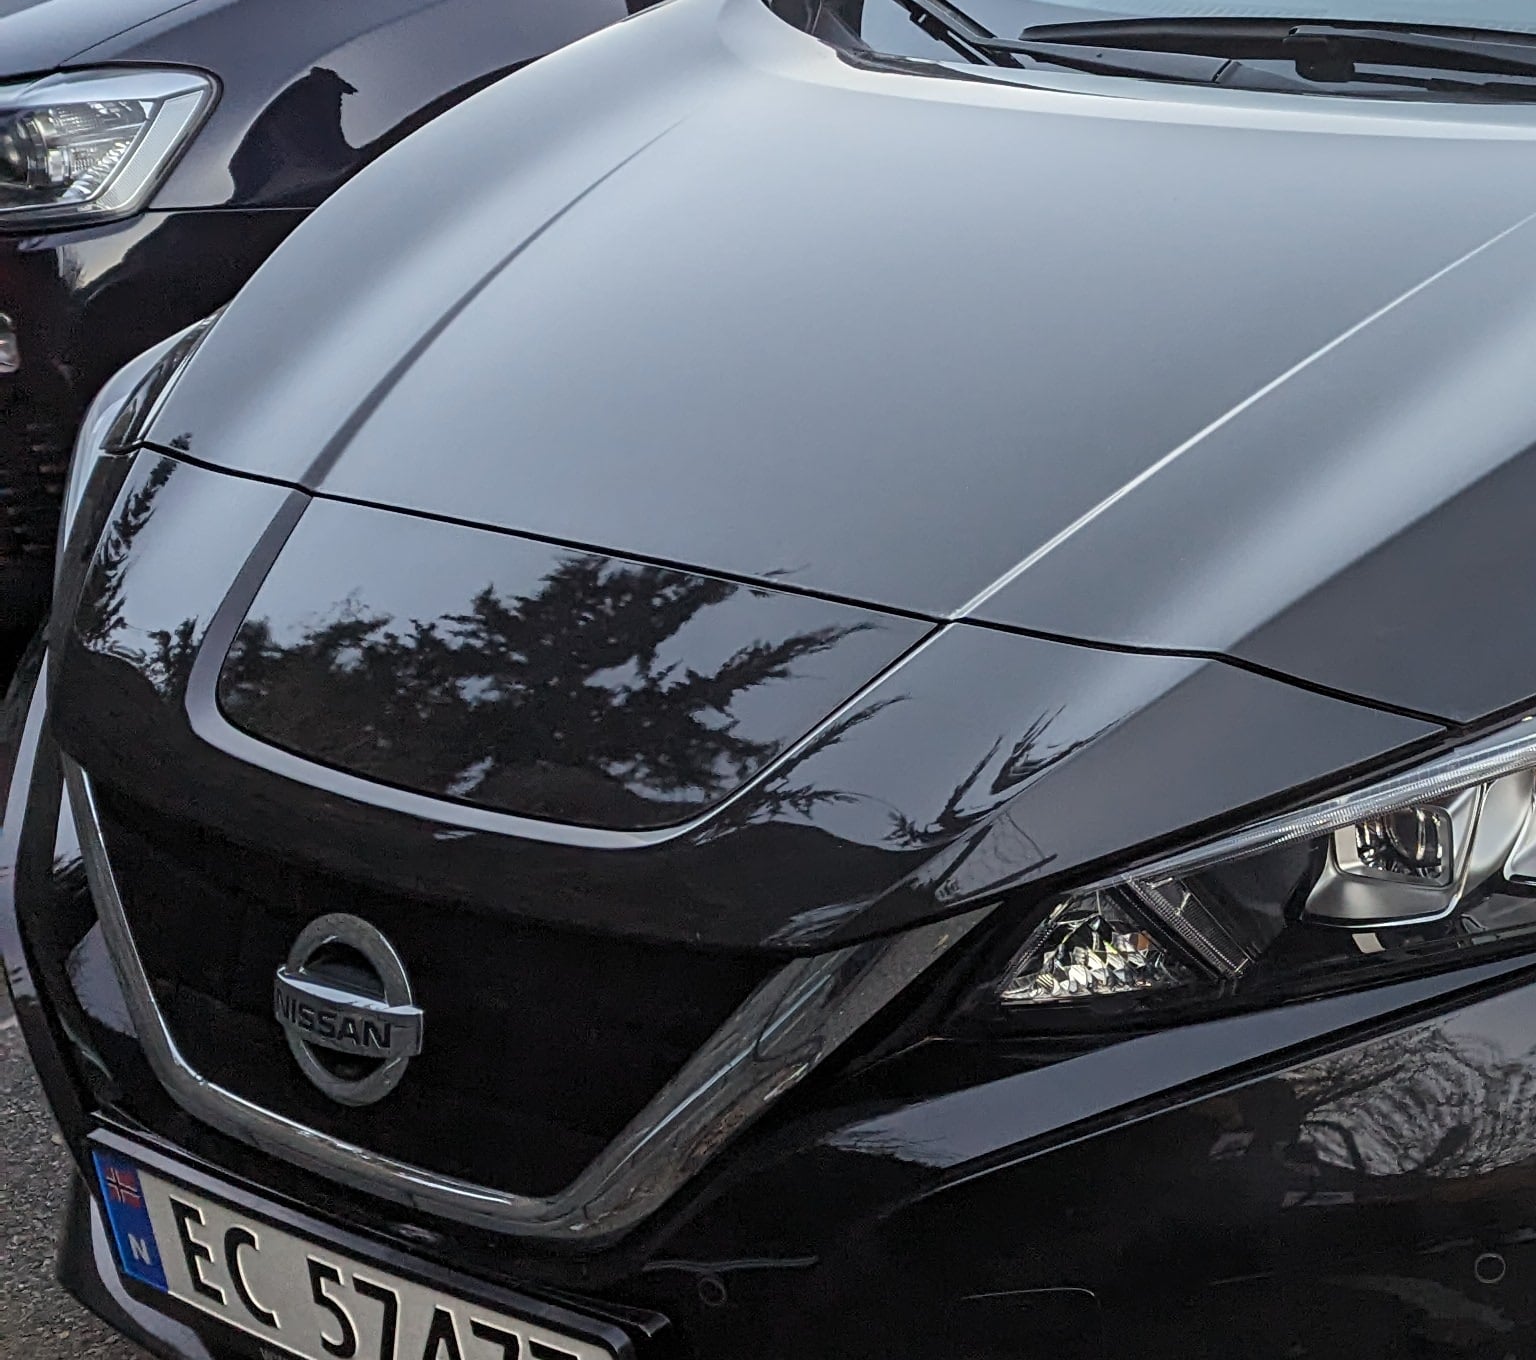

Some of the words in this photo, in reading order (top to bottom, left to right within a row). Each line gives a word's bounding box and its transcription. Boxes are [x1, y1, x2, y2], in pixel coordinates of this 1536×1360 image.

[276, 989, 392, 1049] NISSAN
[128, 1237, 152, 1267] N
[168, 1195, 282, 1329] EC
